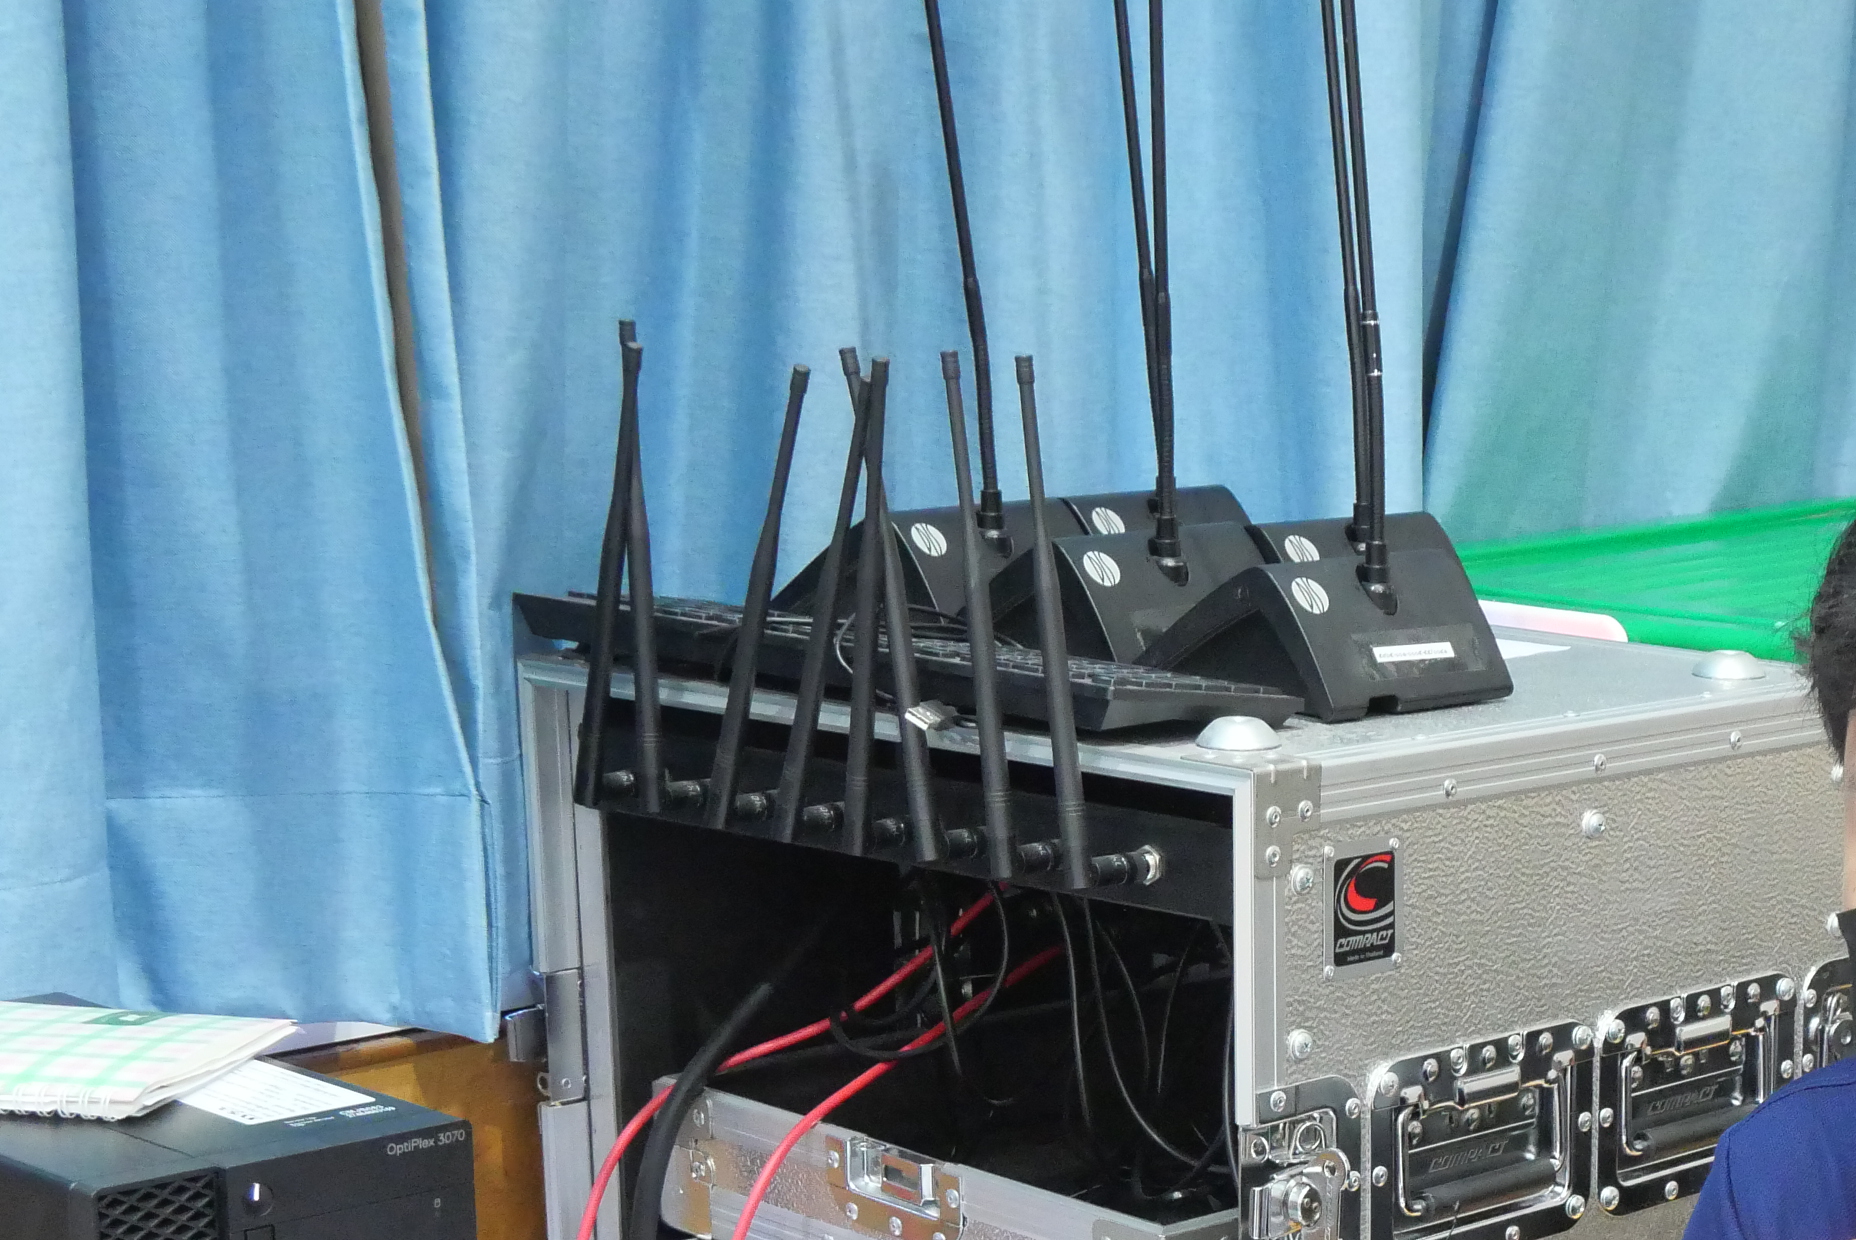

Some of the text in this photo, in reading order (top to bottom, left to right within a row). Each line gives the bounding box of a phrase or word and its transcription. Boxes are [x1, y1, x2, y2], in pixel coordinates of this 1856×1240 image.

[1335, 929, 1394, 953] COMPACT
[1647, 1084, 1718, 1117] COMPACT
[386, 1129, 466, 1157] OptiPlex 3070
[1428, 1139, 1510, 1173] COMPACT
